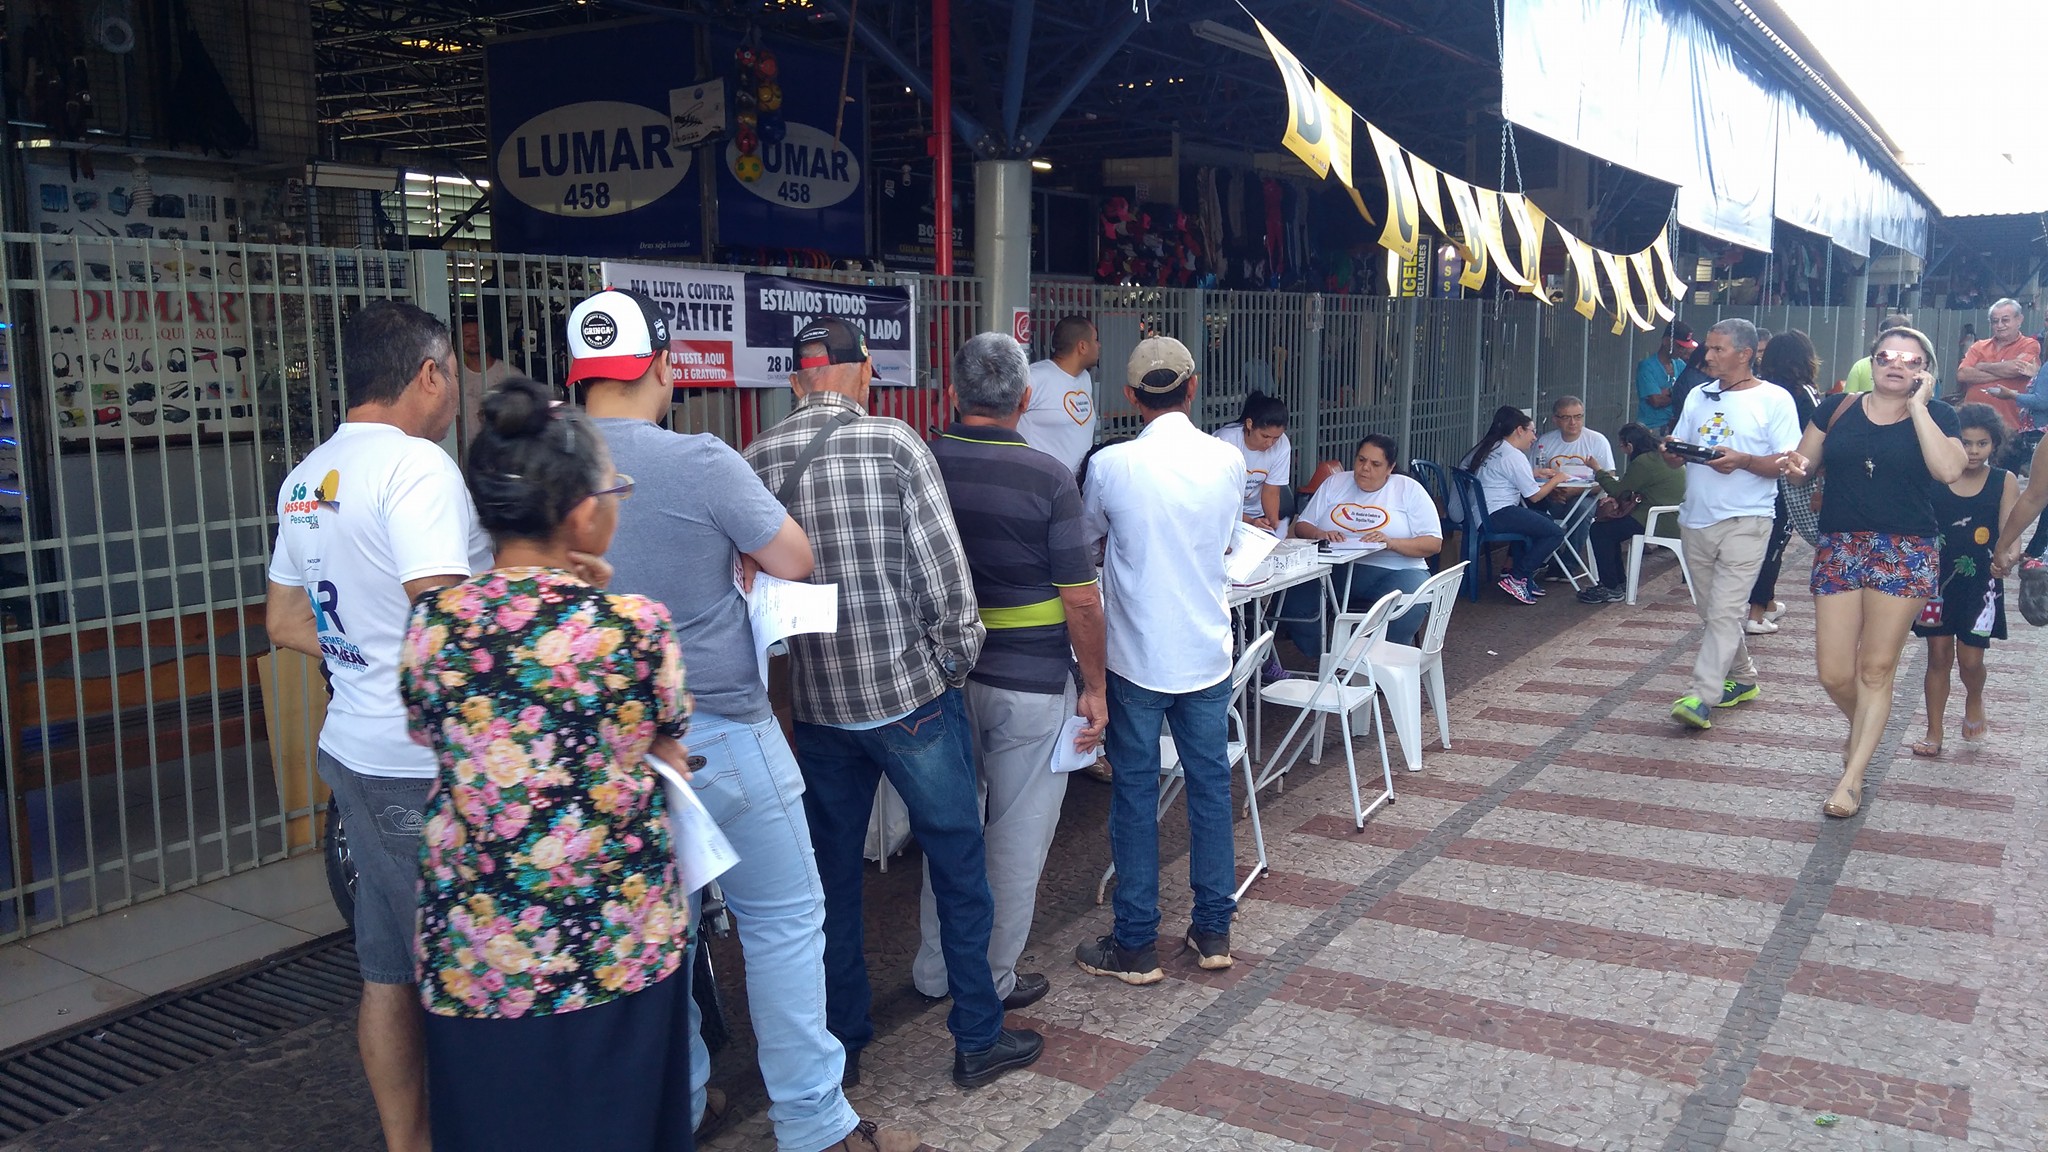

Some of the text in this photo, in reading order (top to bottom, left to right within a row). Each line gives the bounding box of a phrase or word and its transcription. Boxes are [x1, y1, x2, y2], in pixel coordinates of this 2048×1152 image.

[516, 124, 674, 179] LUMAR
[761, 143, 850, 183] UMAR
[563, 182, 610, 211] 458
[778, 181, 811, 204] 458
[1416, 244, 1427, 298] CELULARES
[631, 279, 735, 301] NA LUTA CONTRA
[760, 288, 867, 315] ESTAMOS TODOS
[657, 301, 733, 332] PATITE
[869, 319, 902, 341] LADO
[679, 352, 703, 365] TESTE
[704, 353, 725, 366] AQUI
[767, 356, 793, 372] 28 D
[673, 368, 727, 380] SO E GRATUITO
[290, 514, 318, 525] Pescaria
